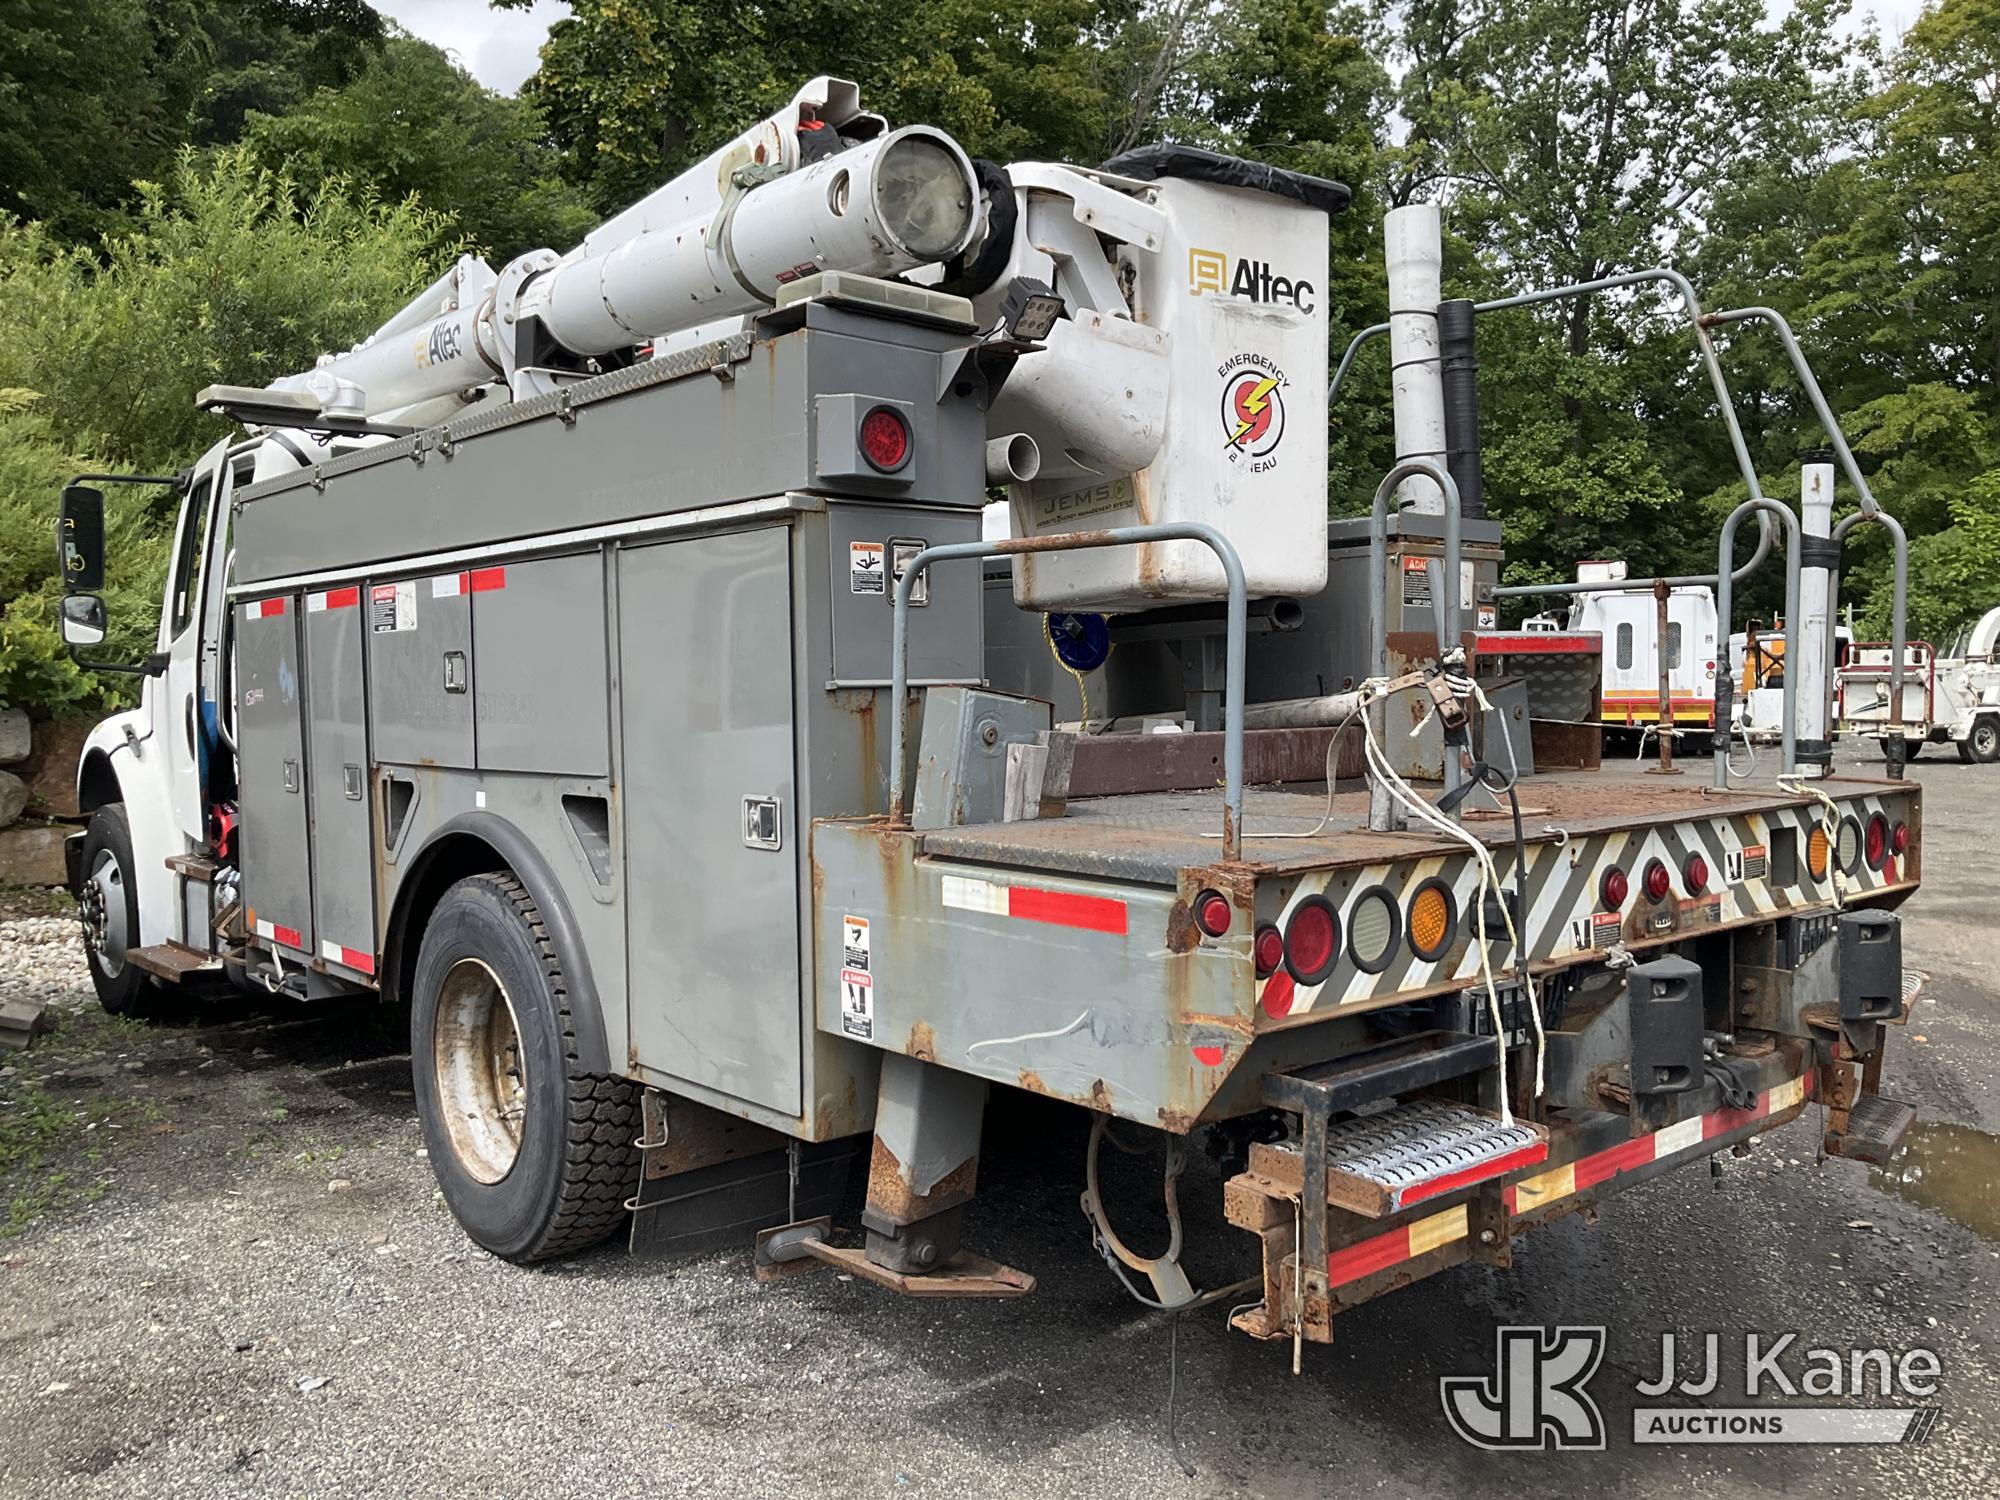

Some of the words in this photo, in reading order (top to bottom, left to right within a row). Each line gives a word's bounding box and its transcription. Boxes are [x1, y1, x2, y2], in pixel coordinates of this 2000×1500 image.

[1230, 257, 1315, 315] Altec
[428, 320, 462, 366] Altec
[1217, 353, 1290, 388] EMERGENCY
[1228, 451, 1277, 473] BEAU
[1043, 484, 1111, 514] JEMS
